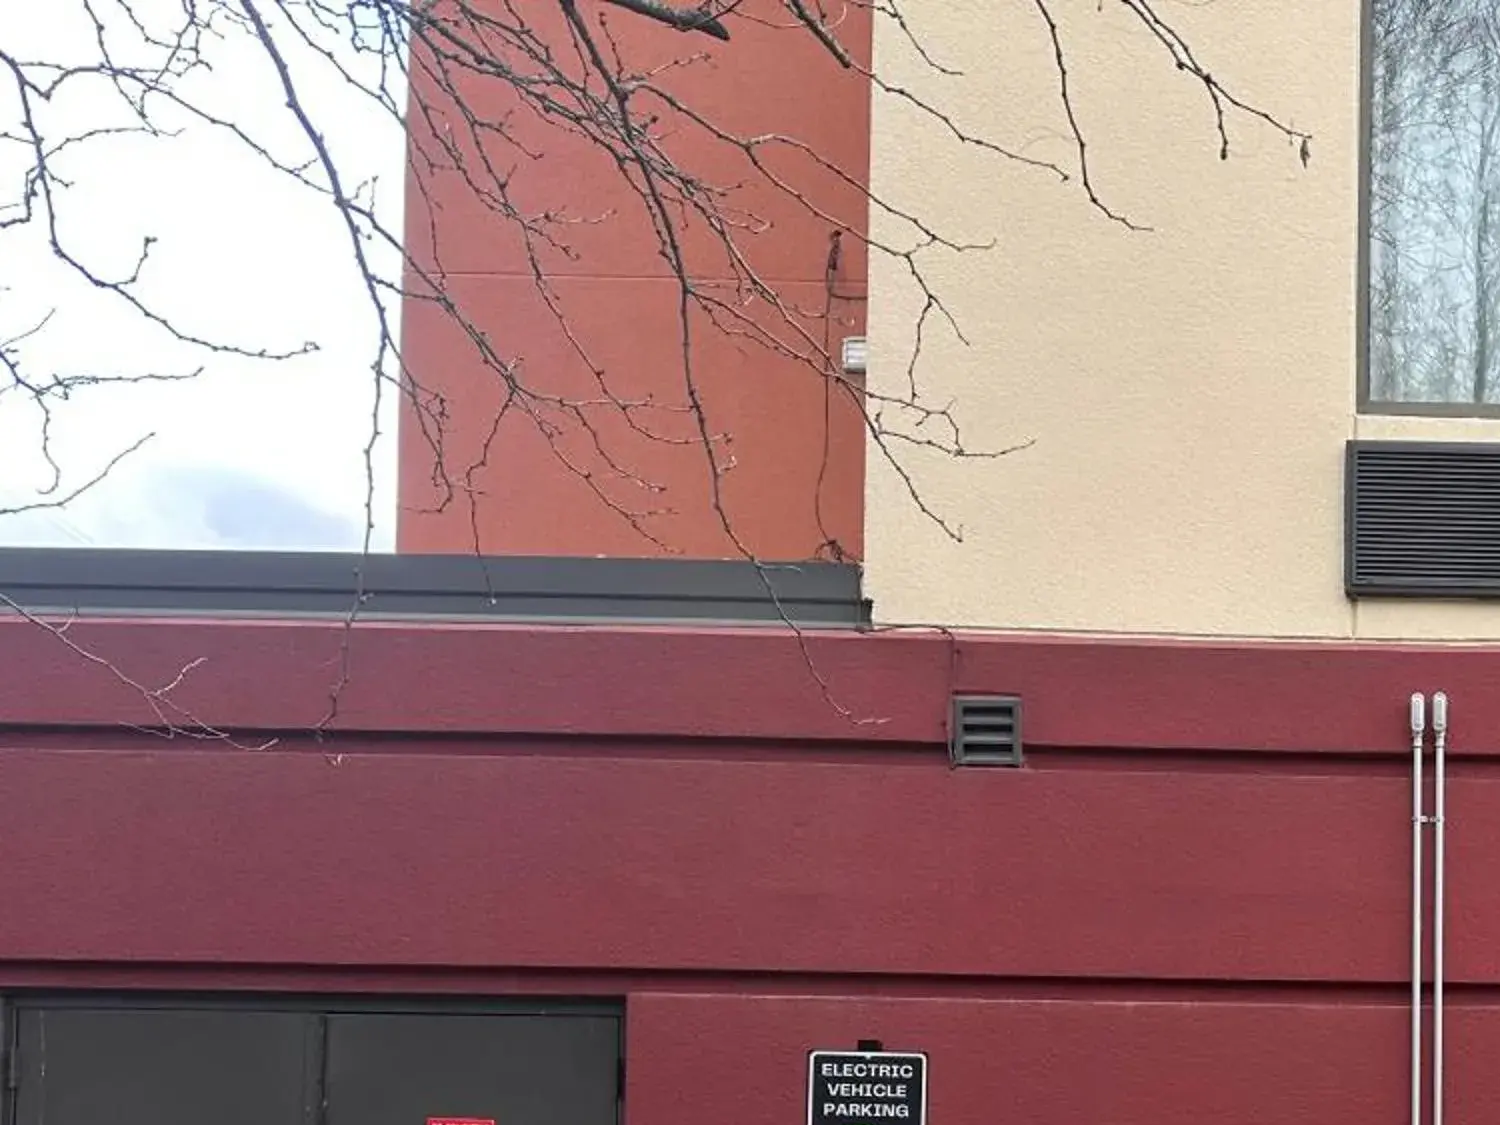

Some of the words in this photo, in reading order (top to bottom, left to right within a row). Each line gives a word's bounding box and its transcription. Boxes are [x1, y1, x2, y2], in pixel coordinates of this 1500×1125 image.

[821, 1063, 913, 1079] ELECTRIC
[826, 1083, 908, 1098] VEHICLE
[823, 1103, 910, 1118] PARKING
